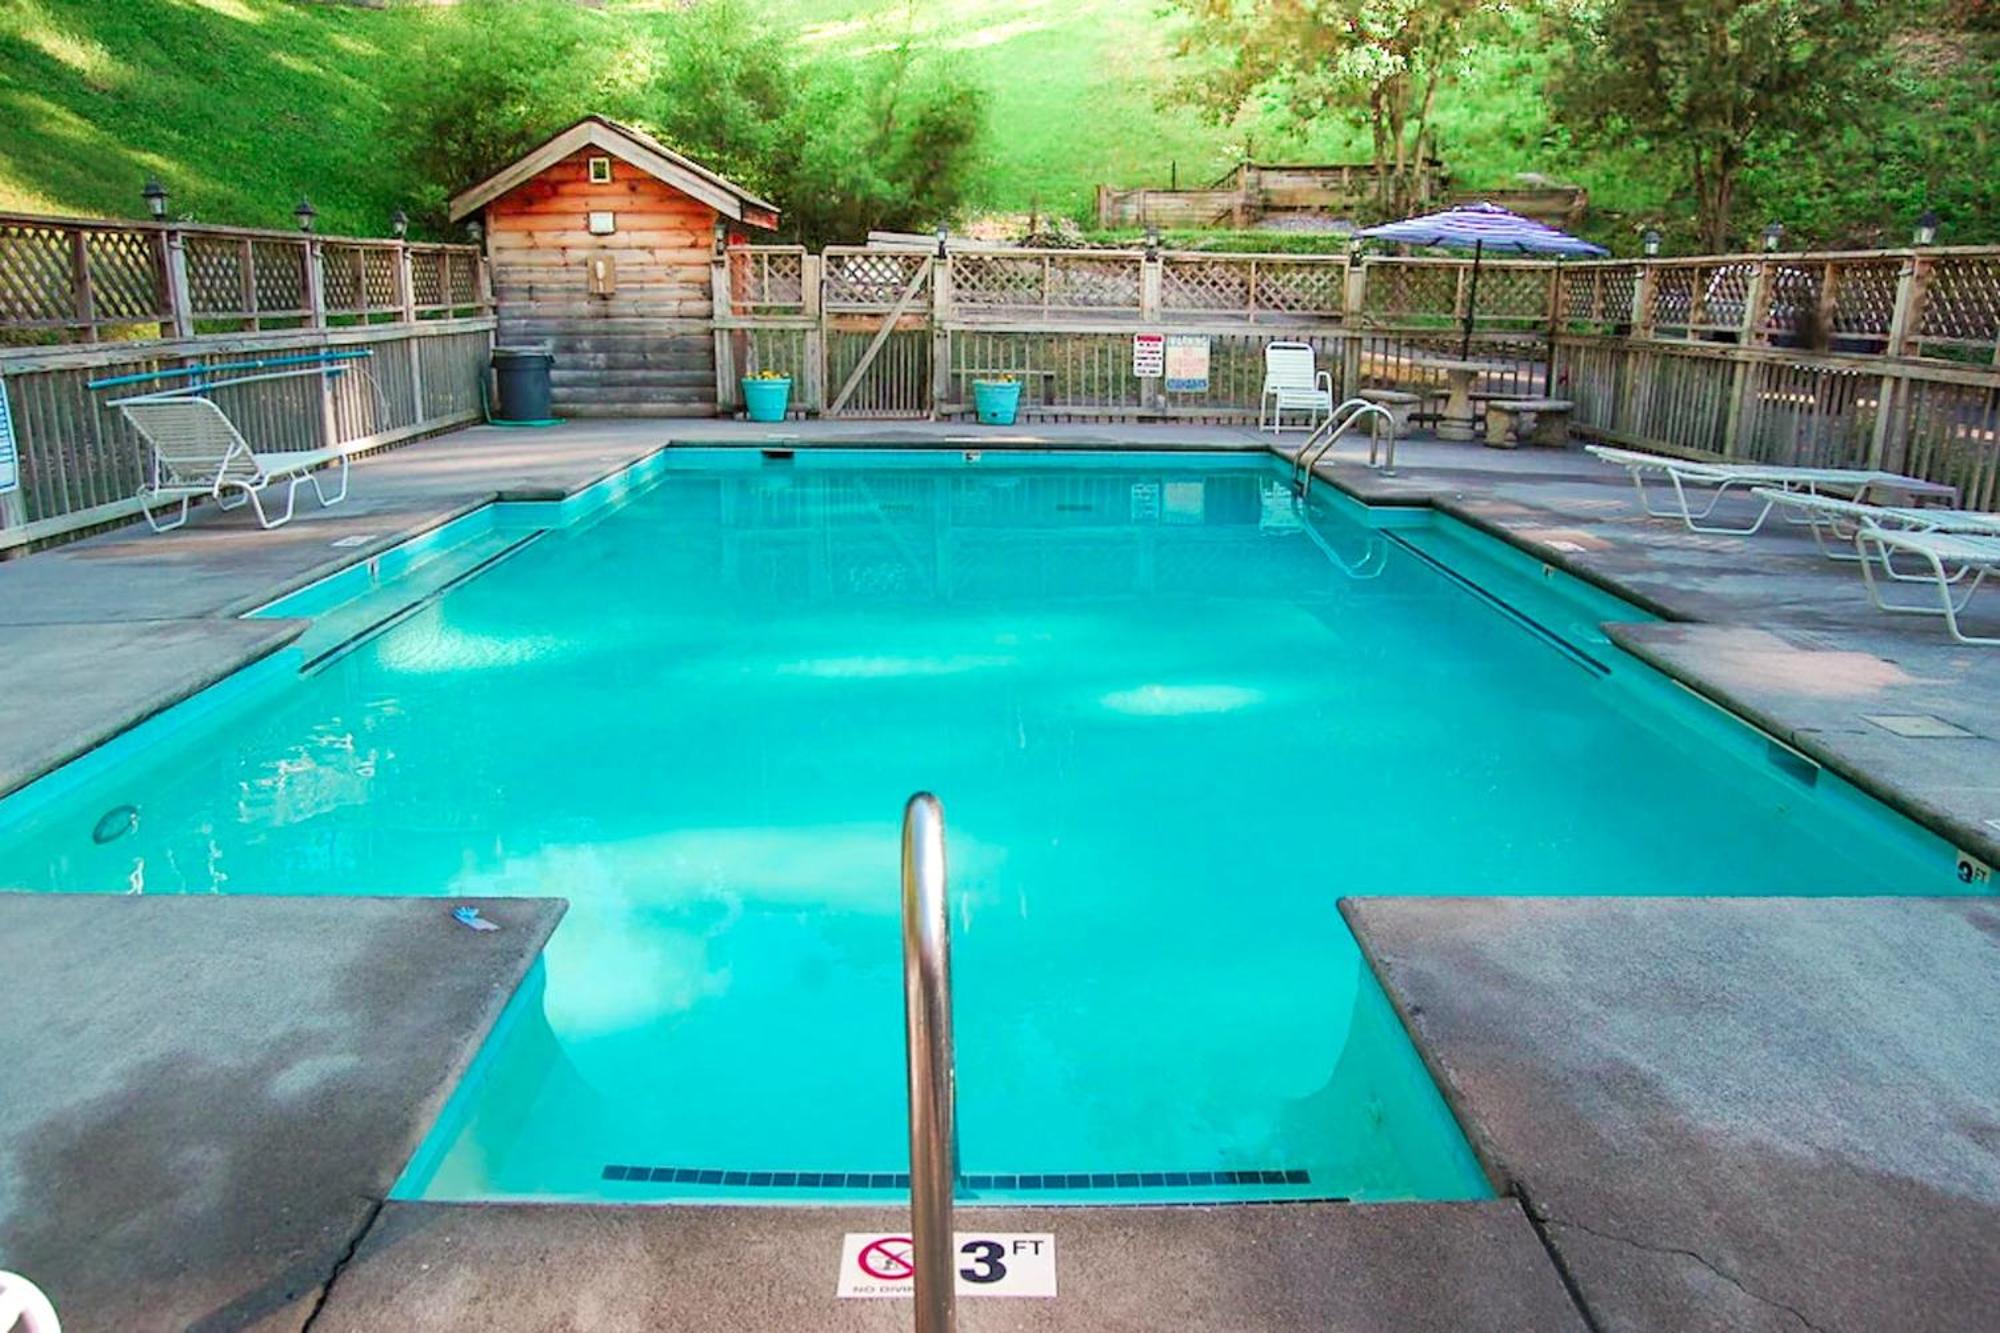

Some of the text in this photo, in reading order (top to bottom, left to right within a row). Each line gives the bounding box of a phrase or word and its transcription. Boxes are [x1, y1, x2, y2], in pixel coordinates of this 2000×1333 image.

[1958, 861, 1973, 884] 3
[960, 1240, 1044, 1284] 3 FT
[853, 1285, 915, 1294] NO DIVIN
